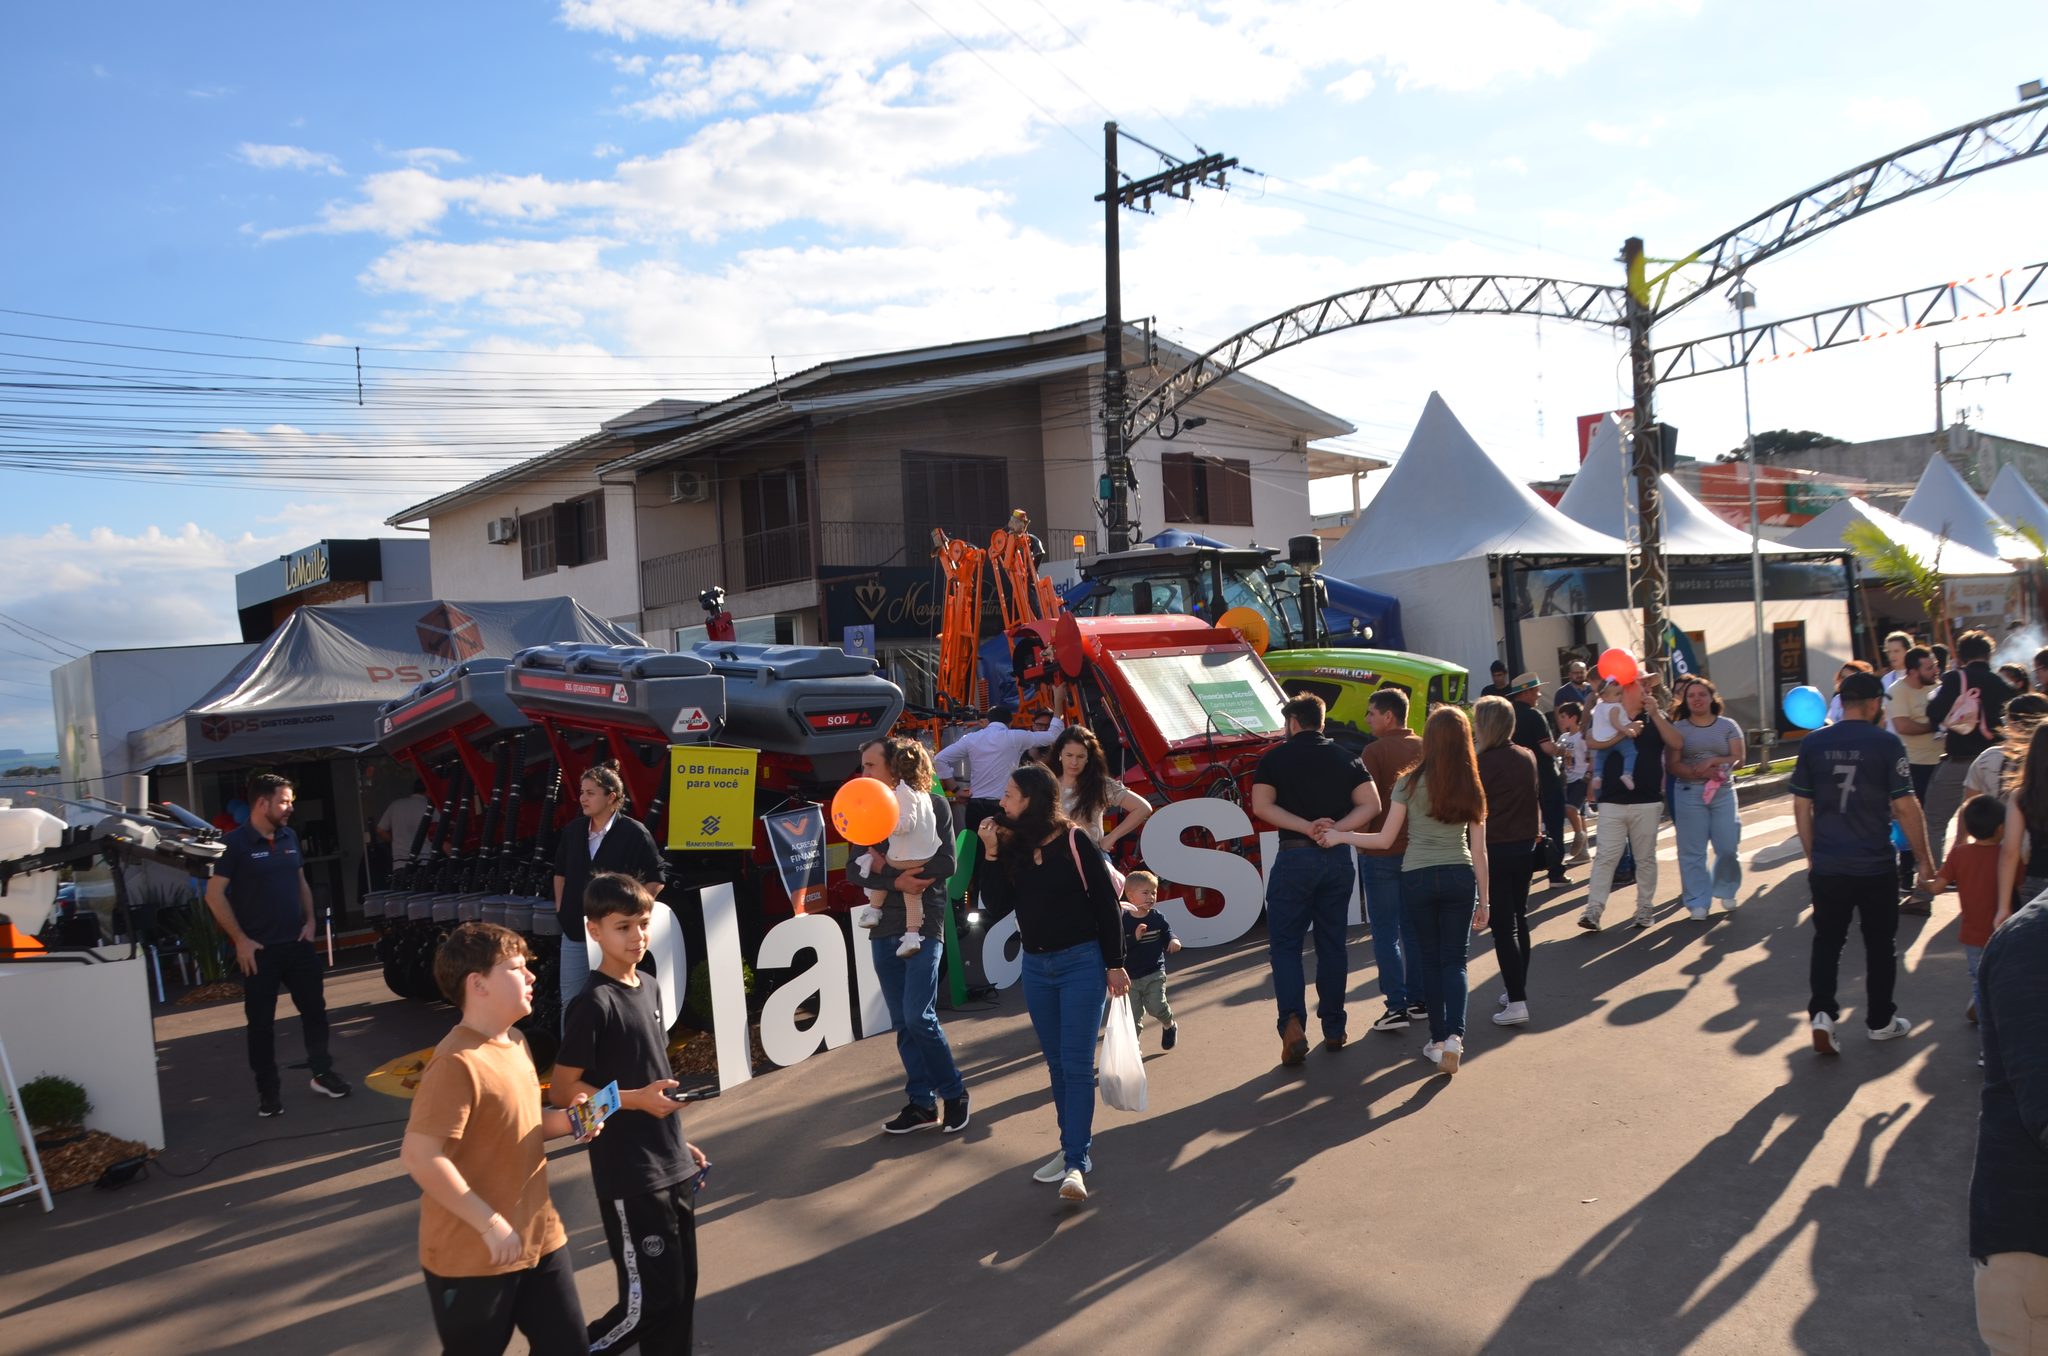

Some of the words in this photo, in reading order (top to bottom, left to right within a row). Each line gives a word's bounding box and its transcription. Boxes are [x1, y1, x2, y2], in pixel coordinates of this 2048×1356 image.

[286, 548, 328, 591] LaMaille
[366, 665, 424, 683] PS
[232, 718, 260, 733] PS
[827, 715, 849, 725] SOL
[677, 764, 686, 775] O
[689, 765, 705, 775] BB
[708, 765, 750, 776] financia
[686, 780, 711, 790] para
[713, 778, 739, 789] você
[1832, 765, 1857, 814] 7
